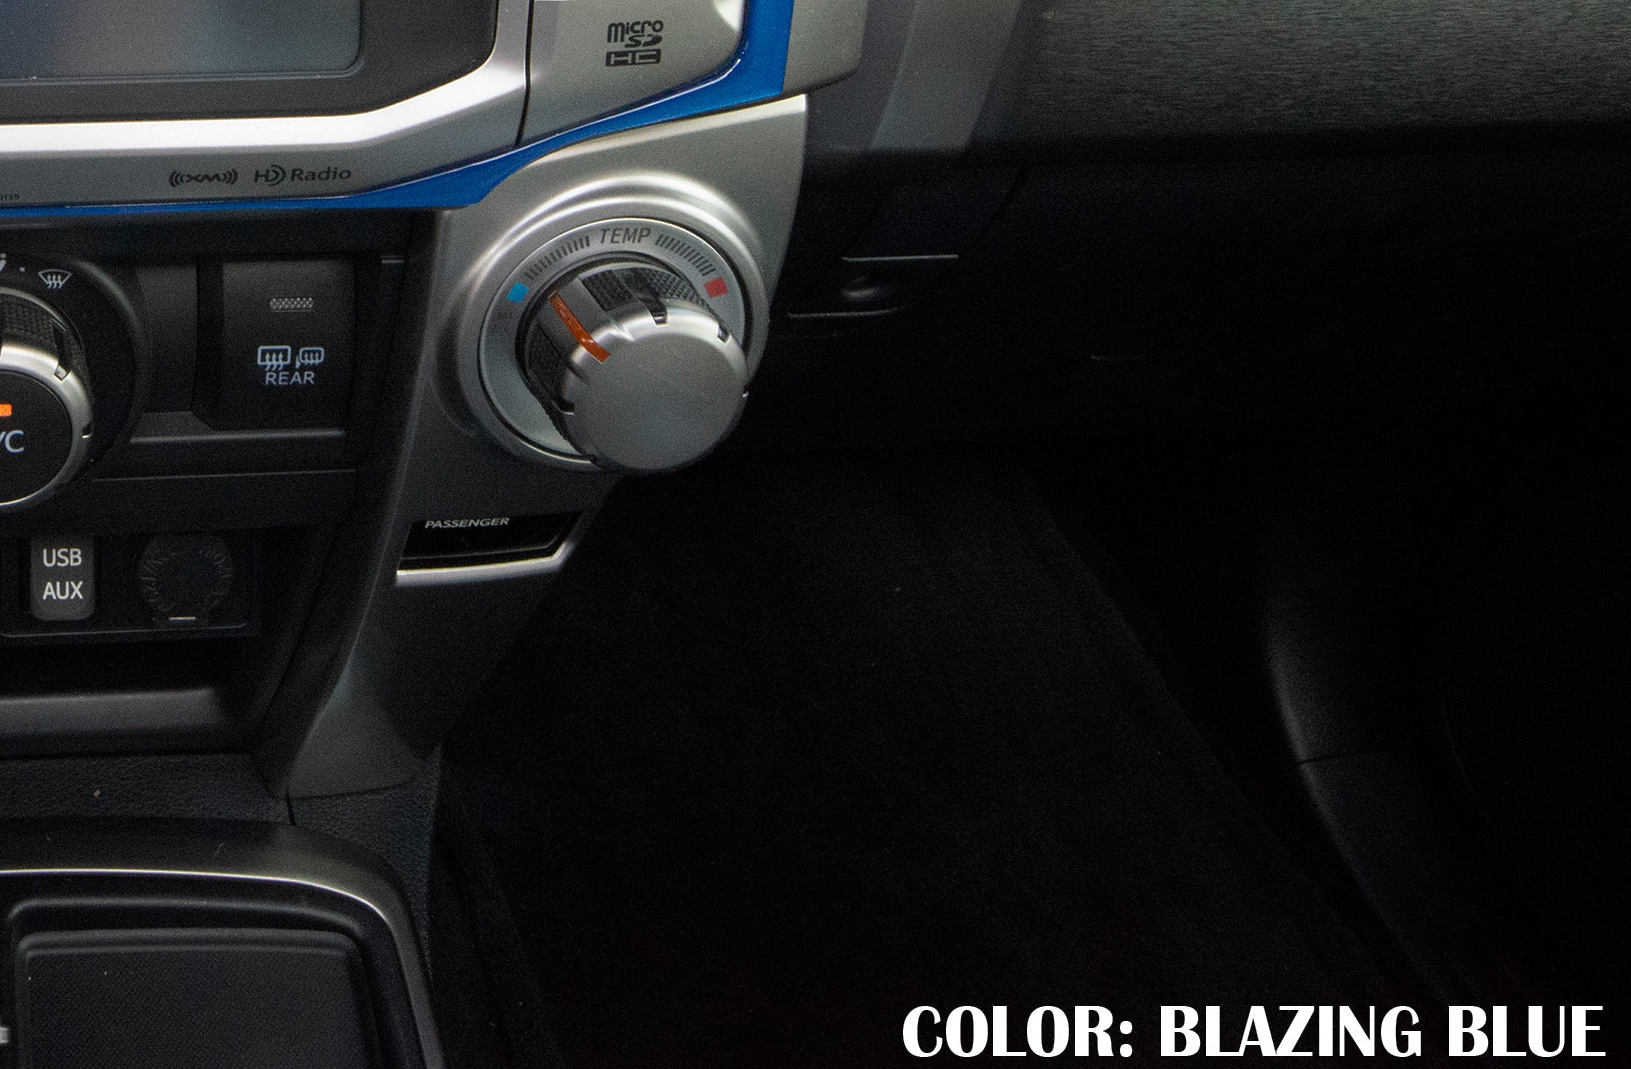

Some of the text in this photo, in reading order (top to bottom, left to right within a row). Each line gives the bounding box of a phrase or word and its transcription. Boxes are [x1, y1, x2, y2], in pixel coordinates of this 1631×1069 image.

[607, 20, 664, 43] micro
[606, 49, 662, 67] HC
[290, 166, 352, 183] Radio
[599, 226, 651, 245] TEMP
[264, 370, 316, 386] REAR
[423, 516, 510, 529] PASSENGER
[42, 548, 82, 568] USB
[42, 581, 84, 601] AUX
